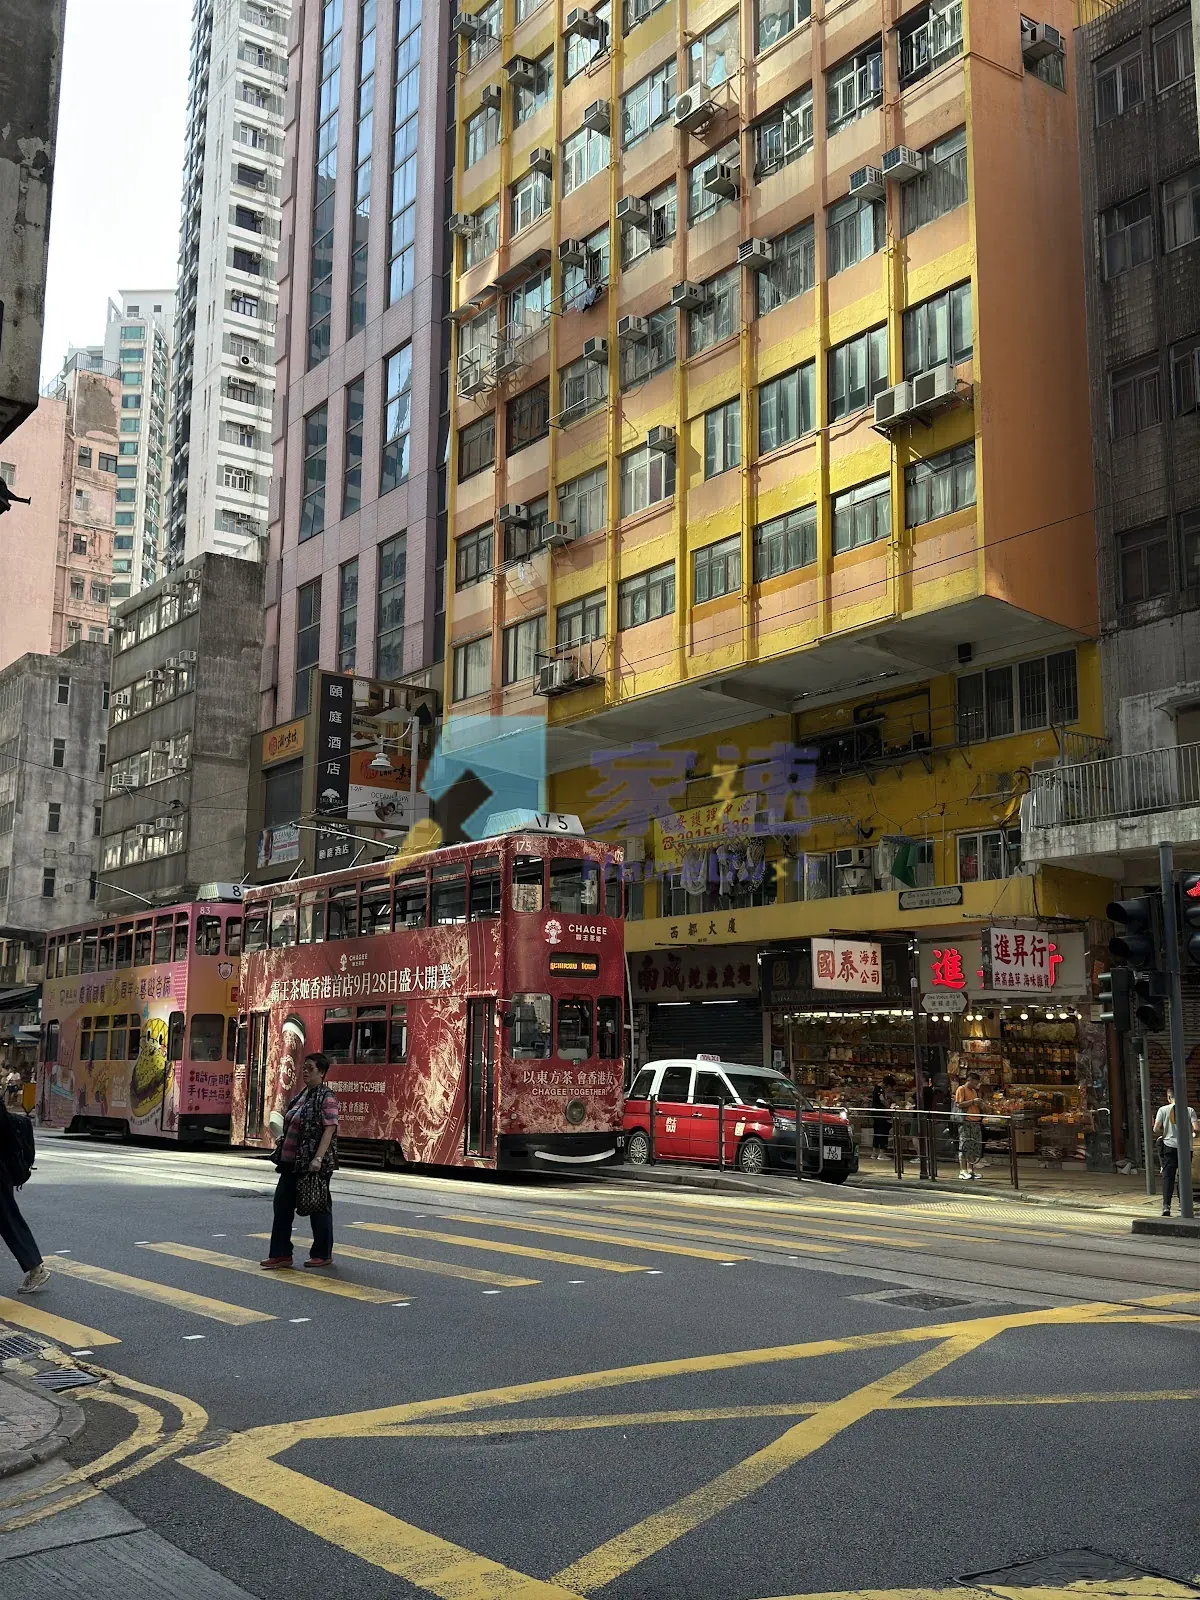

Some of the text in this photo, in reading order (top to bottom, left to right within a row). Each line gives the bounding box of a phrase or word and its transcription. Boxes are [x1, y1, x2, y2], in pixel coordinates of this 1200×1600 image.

[326, 684, 343, 776] 頤庭酒店
[535, 813, 568, 830] 175
[516, 841, 532, 851] 175
[200, 907, 211, 915] 83
[568, 924, 608, 935] CHAGEE
[670, 918, 737, 939] 西都大廈
[994, 934, 1047, 968] 進昇行
[817, 949, 858, 982] 國泰
[860, 969, 880, 985] 公司
[523, 1070, 614, 1085] 以東方茶 會香港友
[532, 1088, 608, 1096] CHAGEE TOGETHER!
